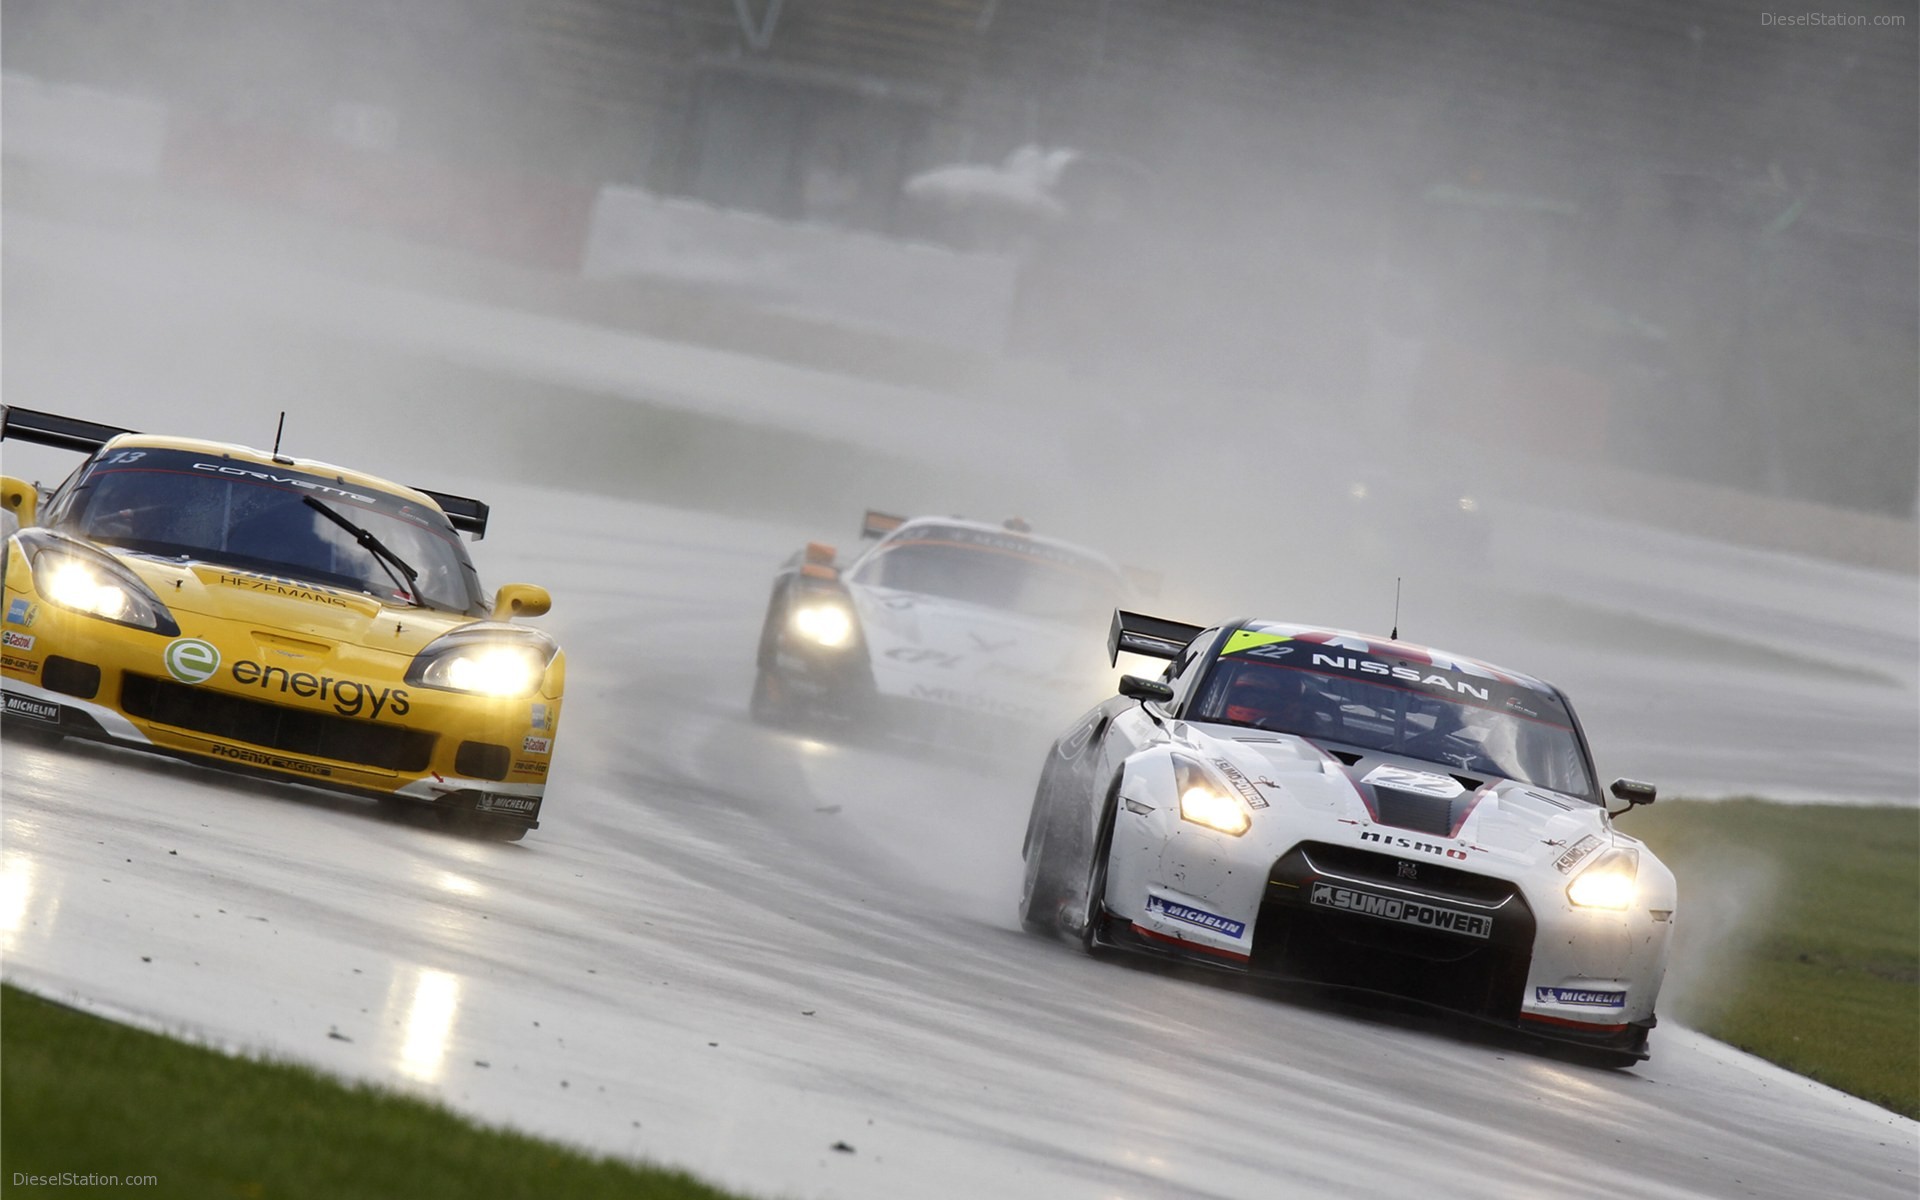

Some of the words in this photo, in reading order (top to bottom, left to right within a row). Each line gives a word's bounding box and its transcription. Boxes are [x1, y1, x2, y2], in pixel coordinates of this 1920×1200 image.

[106, 451, 147, 465] 13
[193, 463, 377, 504] CORVETTE
[1247, 644, 1294, 659] 22
[1311, 653, 1490, 701] NISSAN
[231, 660, 411, 720] energys
[7, 697, 57, 717] MICHELIN
[1375, 769, 1456, 794] 22
[493, 798, 537, 812] MICHELIN
[1360, 831, 1467, 860] nismo
[1168, 905, 1240, 933] MICHELIN
[1560, 991, 1623, 1004] MICHELIN
